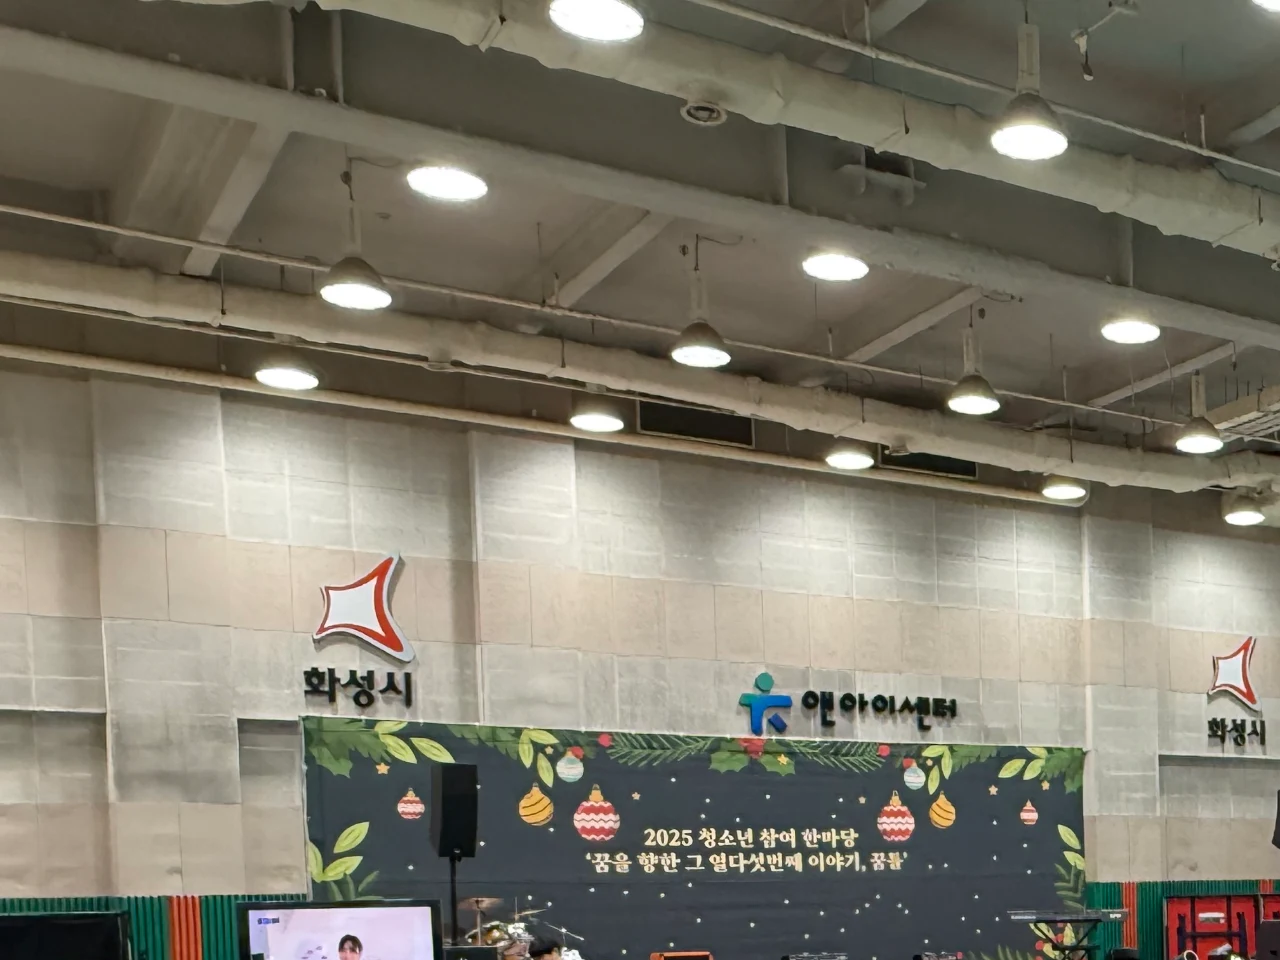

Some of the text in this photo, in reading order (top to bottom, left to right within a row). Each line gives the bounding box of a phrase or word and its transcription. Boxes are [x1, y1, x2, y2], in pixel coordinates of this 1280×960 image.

[303, 667, 412, 708] 화성시
[801, 690, 957, 731] 앤아이센터
[1207, 717, 1266, 746] 화성시
[644, 827, 859, 848] 2025 청소년 참여 한마당
[637, 852, 681, 874] 향한
[685, 854, 706, 871] 그
[708, 852, 804, 874] 열다섯번째
[808, 851, 867, 873] 이야기,
